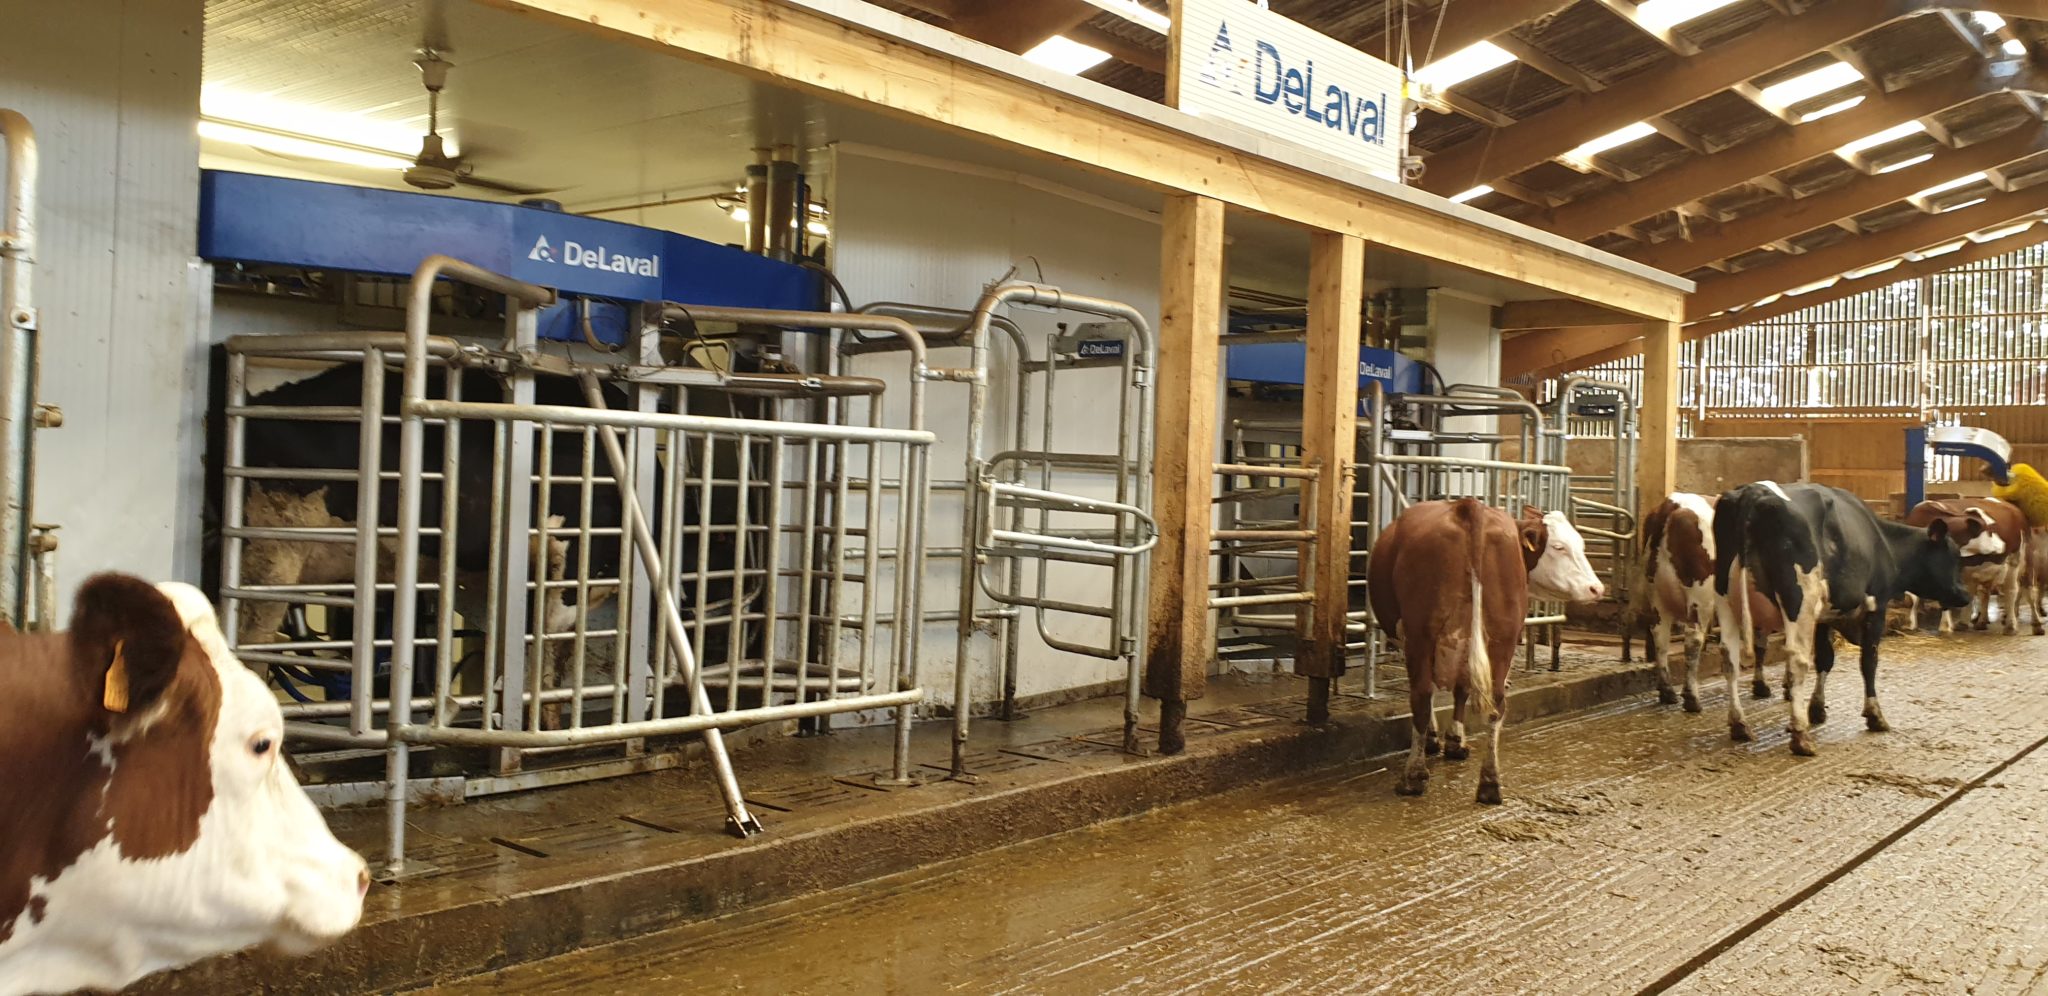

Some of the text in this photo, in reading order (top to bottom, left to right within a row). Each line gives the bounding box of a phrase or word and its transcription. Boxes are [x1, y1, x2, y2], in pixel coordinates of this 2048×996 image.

[1254, 39, 1387, 146] DeLaval
[563, 240, 660, 278] DeLaval
[1089, 344, 1121, 354] DeLaval
[1359, 361, 1393, 380] DeLaval
